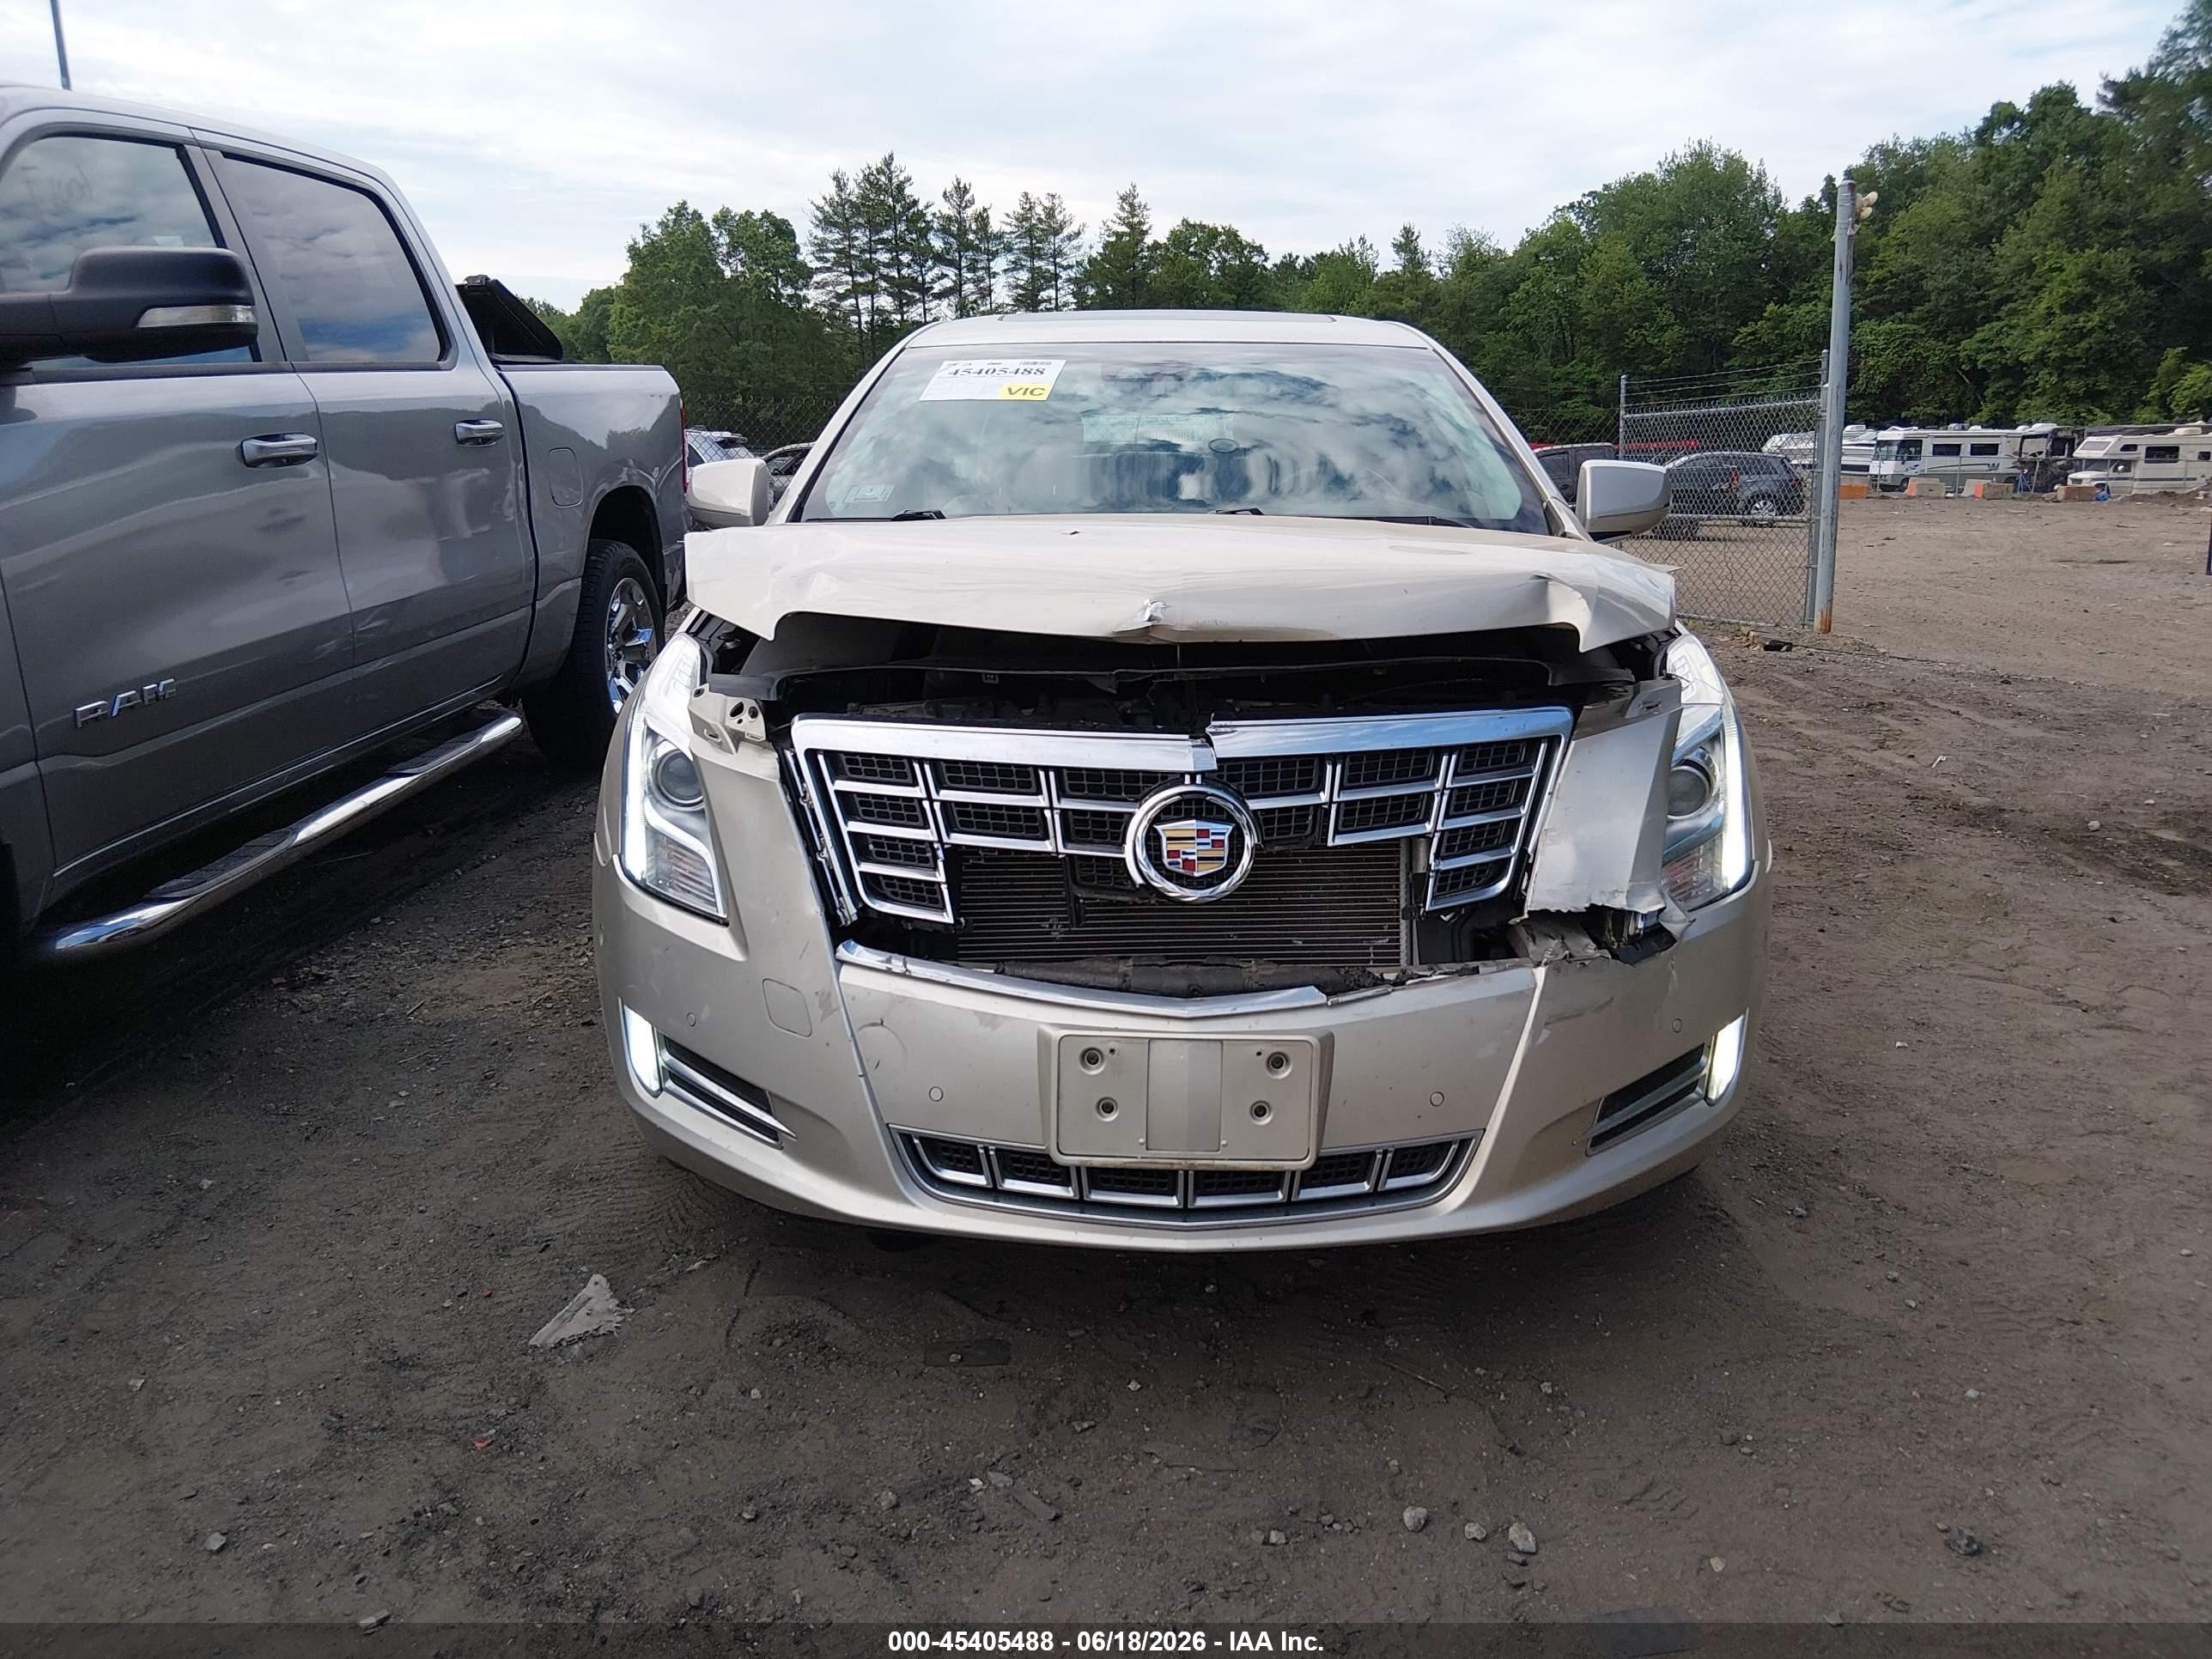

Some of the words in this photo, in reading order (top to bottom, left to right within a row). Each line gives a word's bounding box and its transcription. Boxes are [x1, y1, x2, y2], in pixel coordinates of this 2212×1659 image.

[948, 368, 1046, 376] 45405488
[1006, 386, 1046, 397] VIC
[75, 678, 176, 728] RAM
